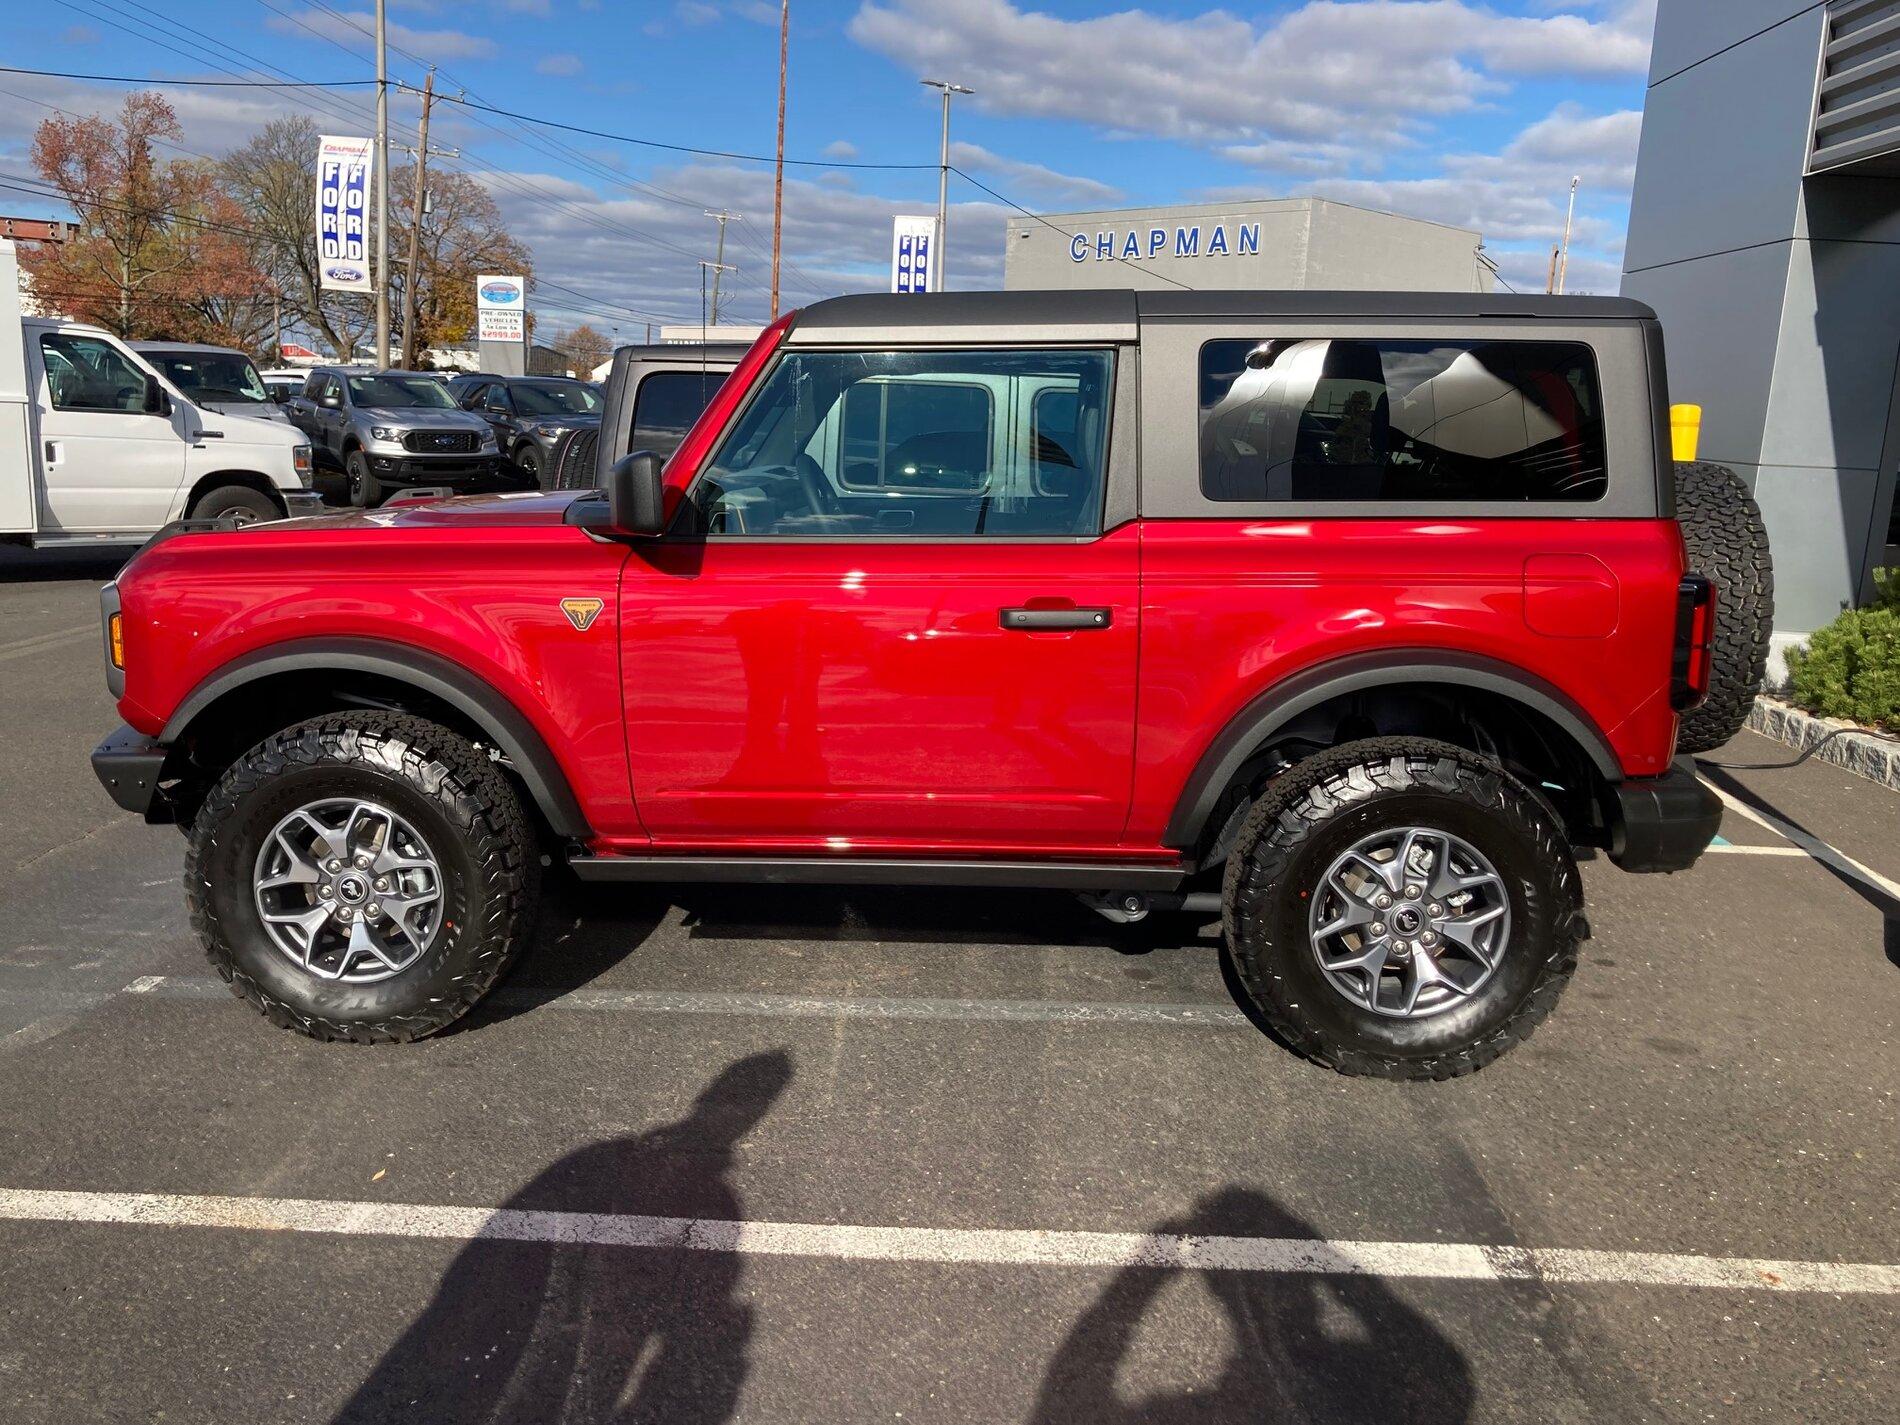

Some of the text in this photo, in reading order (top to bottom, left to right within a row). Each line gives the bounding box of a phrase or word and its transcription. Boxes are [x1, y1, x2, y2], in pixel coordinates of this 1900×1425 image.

[323, 163, 340, 258] FORD
[347, 165, 364, 260] FORD
[899, 236, 911, 293] FOR
[915, 237, 927, 293] FOR
[1070, 223, 1261, 262] CHAPMAN
